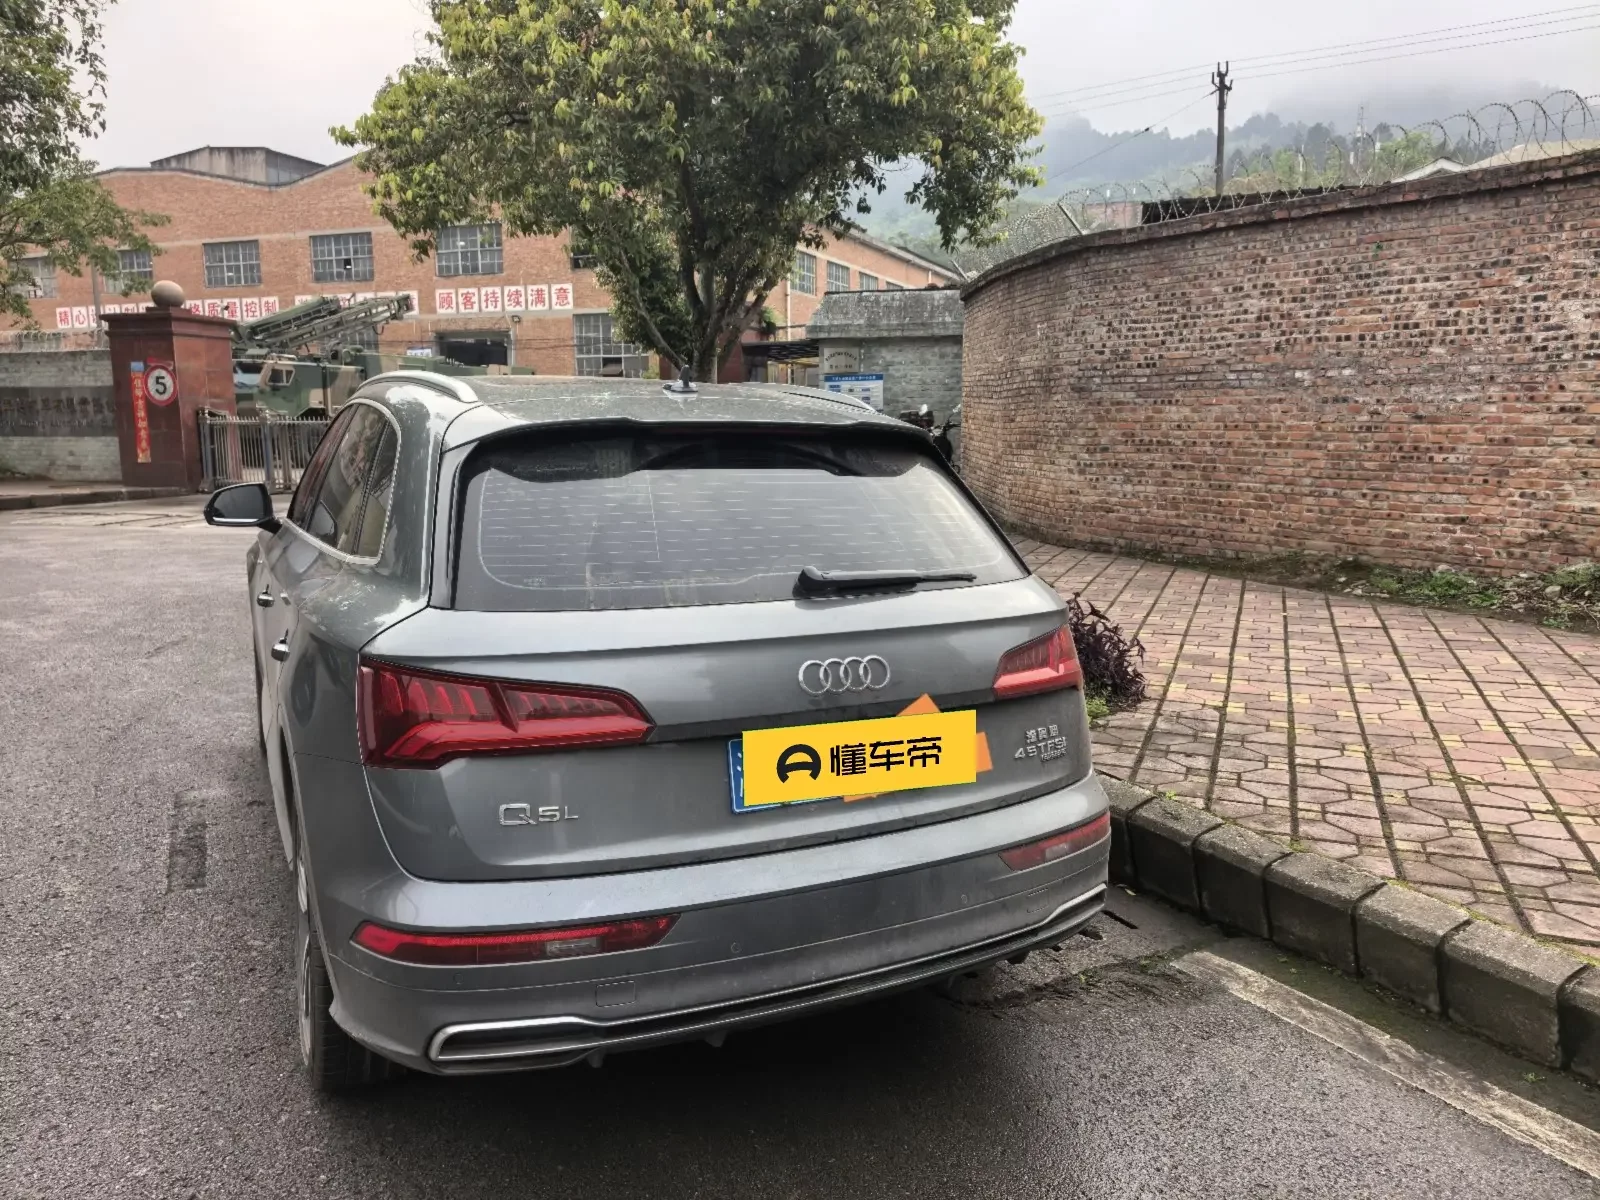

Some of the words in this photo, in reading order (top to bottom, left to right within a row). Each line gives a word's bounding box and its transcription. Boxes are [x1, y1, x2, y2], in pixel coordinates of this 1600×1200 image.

[438, 287, 571, 310] 顾客持续满意
[155, 375, 167, 395] 5
[498, 803, 579, 826] Q5L
